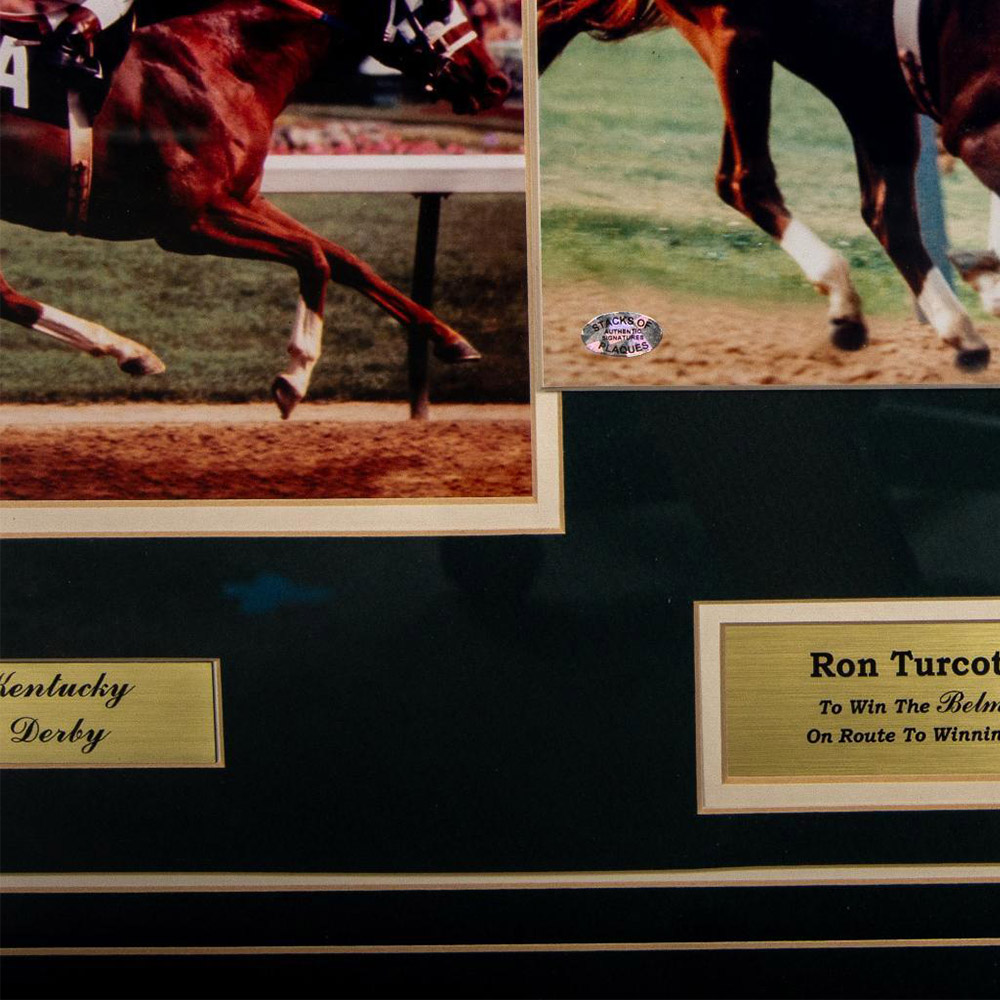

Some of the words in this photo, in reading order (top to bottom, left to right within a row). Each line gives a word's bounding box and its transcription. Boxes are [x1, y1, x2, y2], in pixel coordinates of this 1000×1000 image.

[592, 316, 634, 332] STACKS
[637, 318, 653, 329] OF
[598, 341, 649, 354] PLAQUES
[810, 652, 879, 678] Ron
[819, 699, 843, 715] To
[850, 698, 888, 714] Win
[895, 698, 931, 714] The
[10, 716, 112, 755] Derby
[806, 728, 834, 744] On
[838, 727, 897, 744] Route
[903, 727, 927, 742] To
